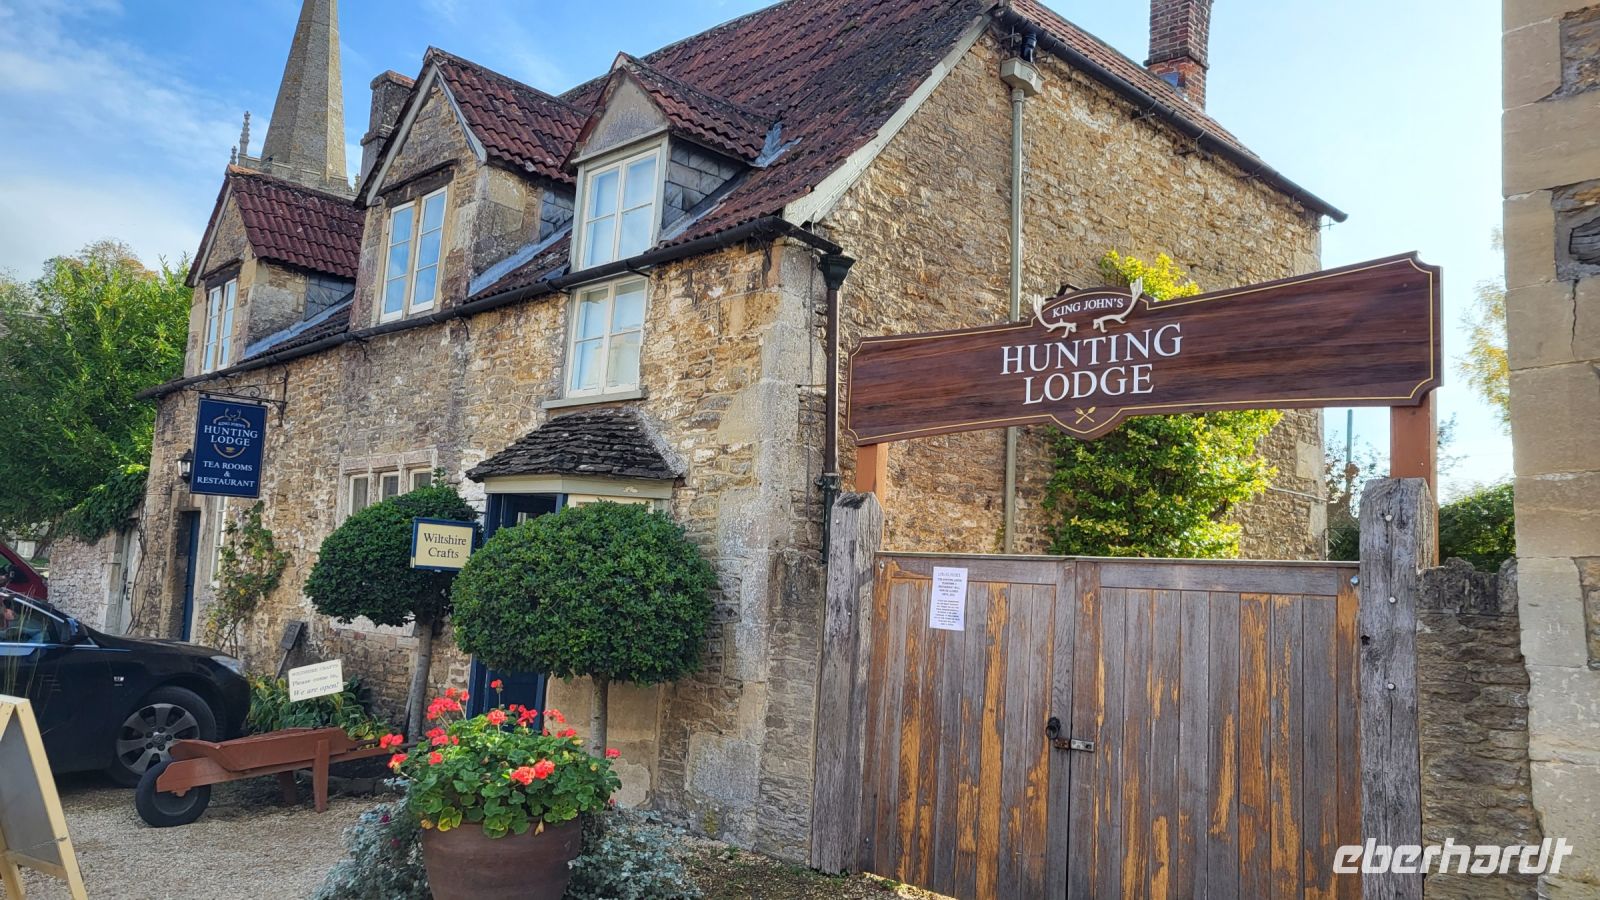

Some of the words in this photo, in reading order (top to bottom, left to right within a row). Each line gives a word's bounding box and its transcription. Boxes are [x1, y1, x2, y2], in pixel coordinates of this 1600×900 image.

[1052, 301, 1081, 318] KING
[1083, 298, 1124, 311] JOHN'S
[999, 322, 1184, 375] HUNTING
[1022, 363, 1155, 405] LODGE
[204, 425, 258, 439] HUNTING
[210, 434, 250, 447] LODGE
[203, 460, 220, 469] TEA
[222, 462, 253, 472] ROOMS
[223, 470, 231, 478] &
[197, 476, 255, 488] RESTAURANT
[423, 532, 467, 546] Wiltshire
[428, 546, 459, 559] Crafts
